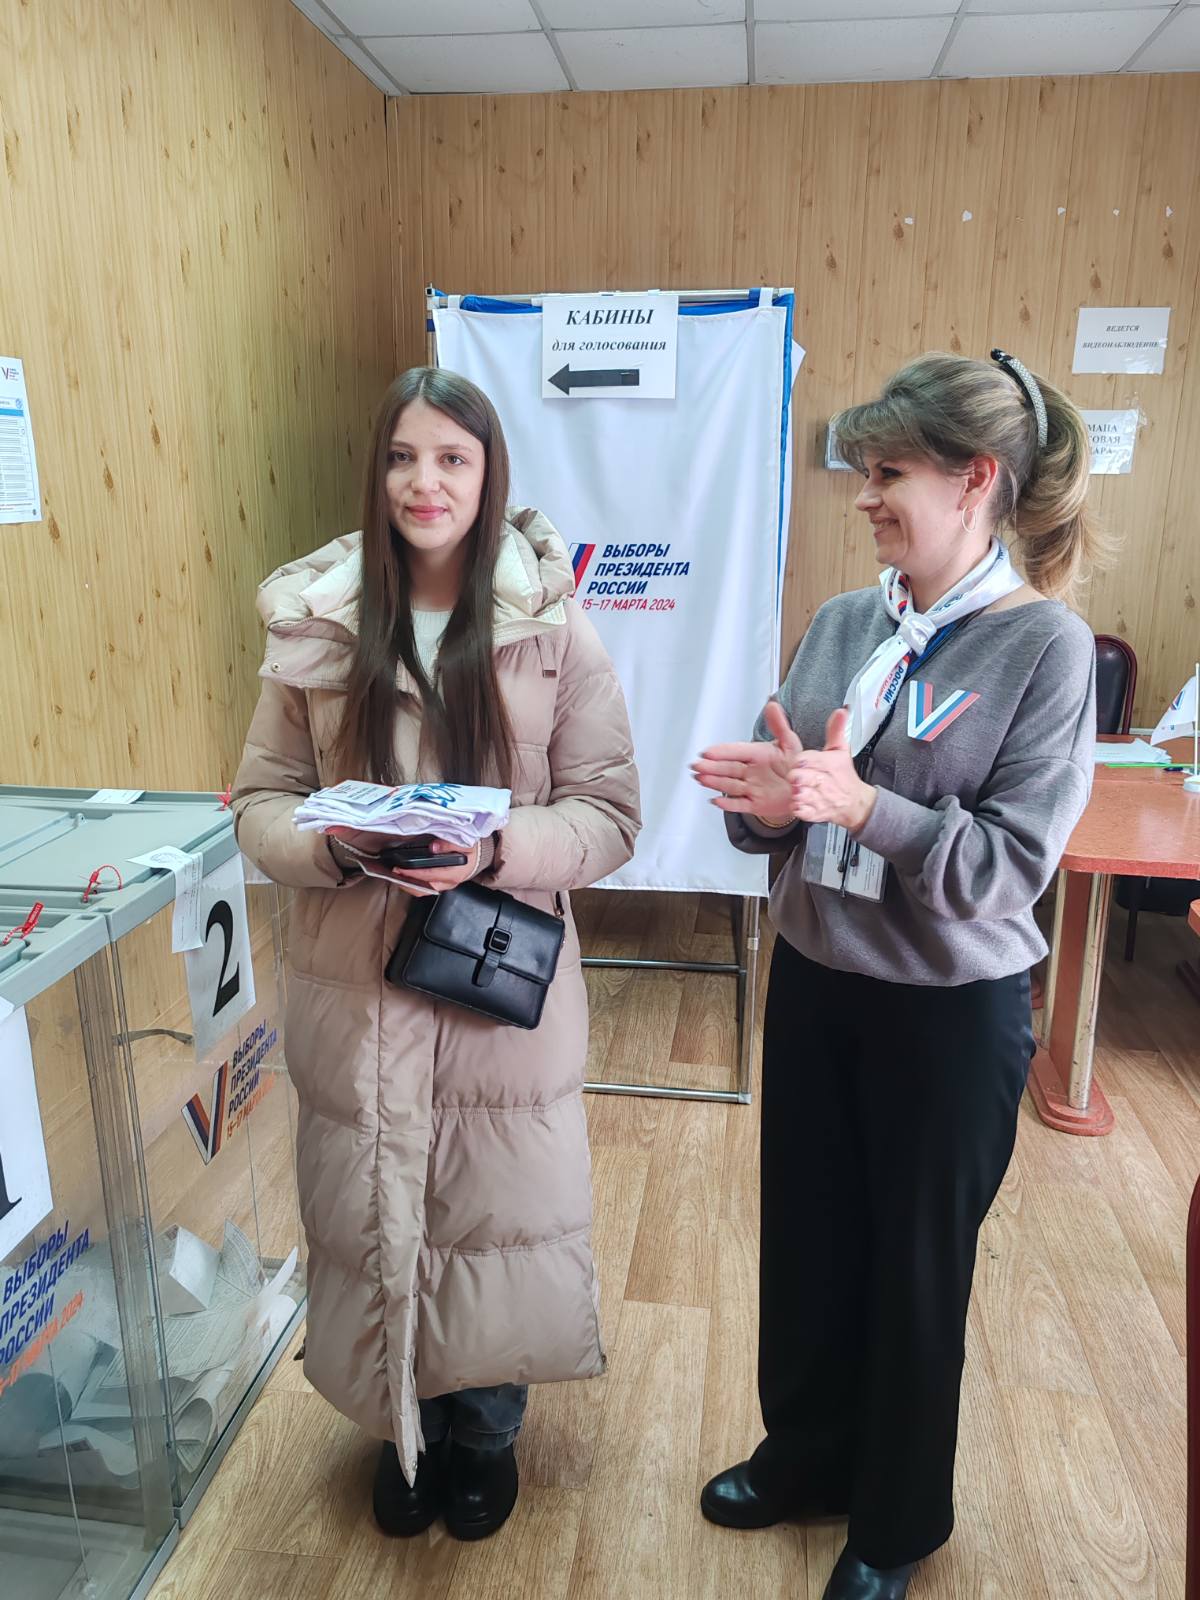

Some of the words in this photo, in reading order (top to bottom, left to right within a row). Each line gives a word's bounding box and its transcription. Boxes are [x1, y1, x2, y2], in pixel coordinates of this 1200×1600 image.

[566, 309, 655, 326] КАБИНЫ
[552, 339, 576, 352] для
[579, 340, 667, 351] голосования
[602, 543, 671, 558] ВЫБОРЫ
[587, 581, 648, 595] РОССИИ
[594, 562, 690, 578] ПРЕЗИДЕНТА
[611, 599, 647, 610] МАРТА
[649, 599, 676, 610] 2024
[883, 665, 905, 703] РОССИИ
[205, 900, 240, 1017] 2
[230, 1028, 278, 1094] ПРЕЗИДЕНТА
[232, 1019, 267, 1069] ВЫБОРЫ
[228, 1067, 260, 1119] РОССИИ
[3, 1219, 69, 1305] ВЫБОРЫ
[0, 1228, 90, 1340] ПРЕЗИДЕНТА
